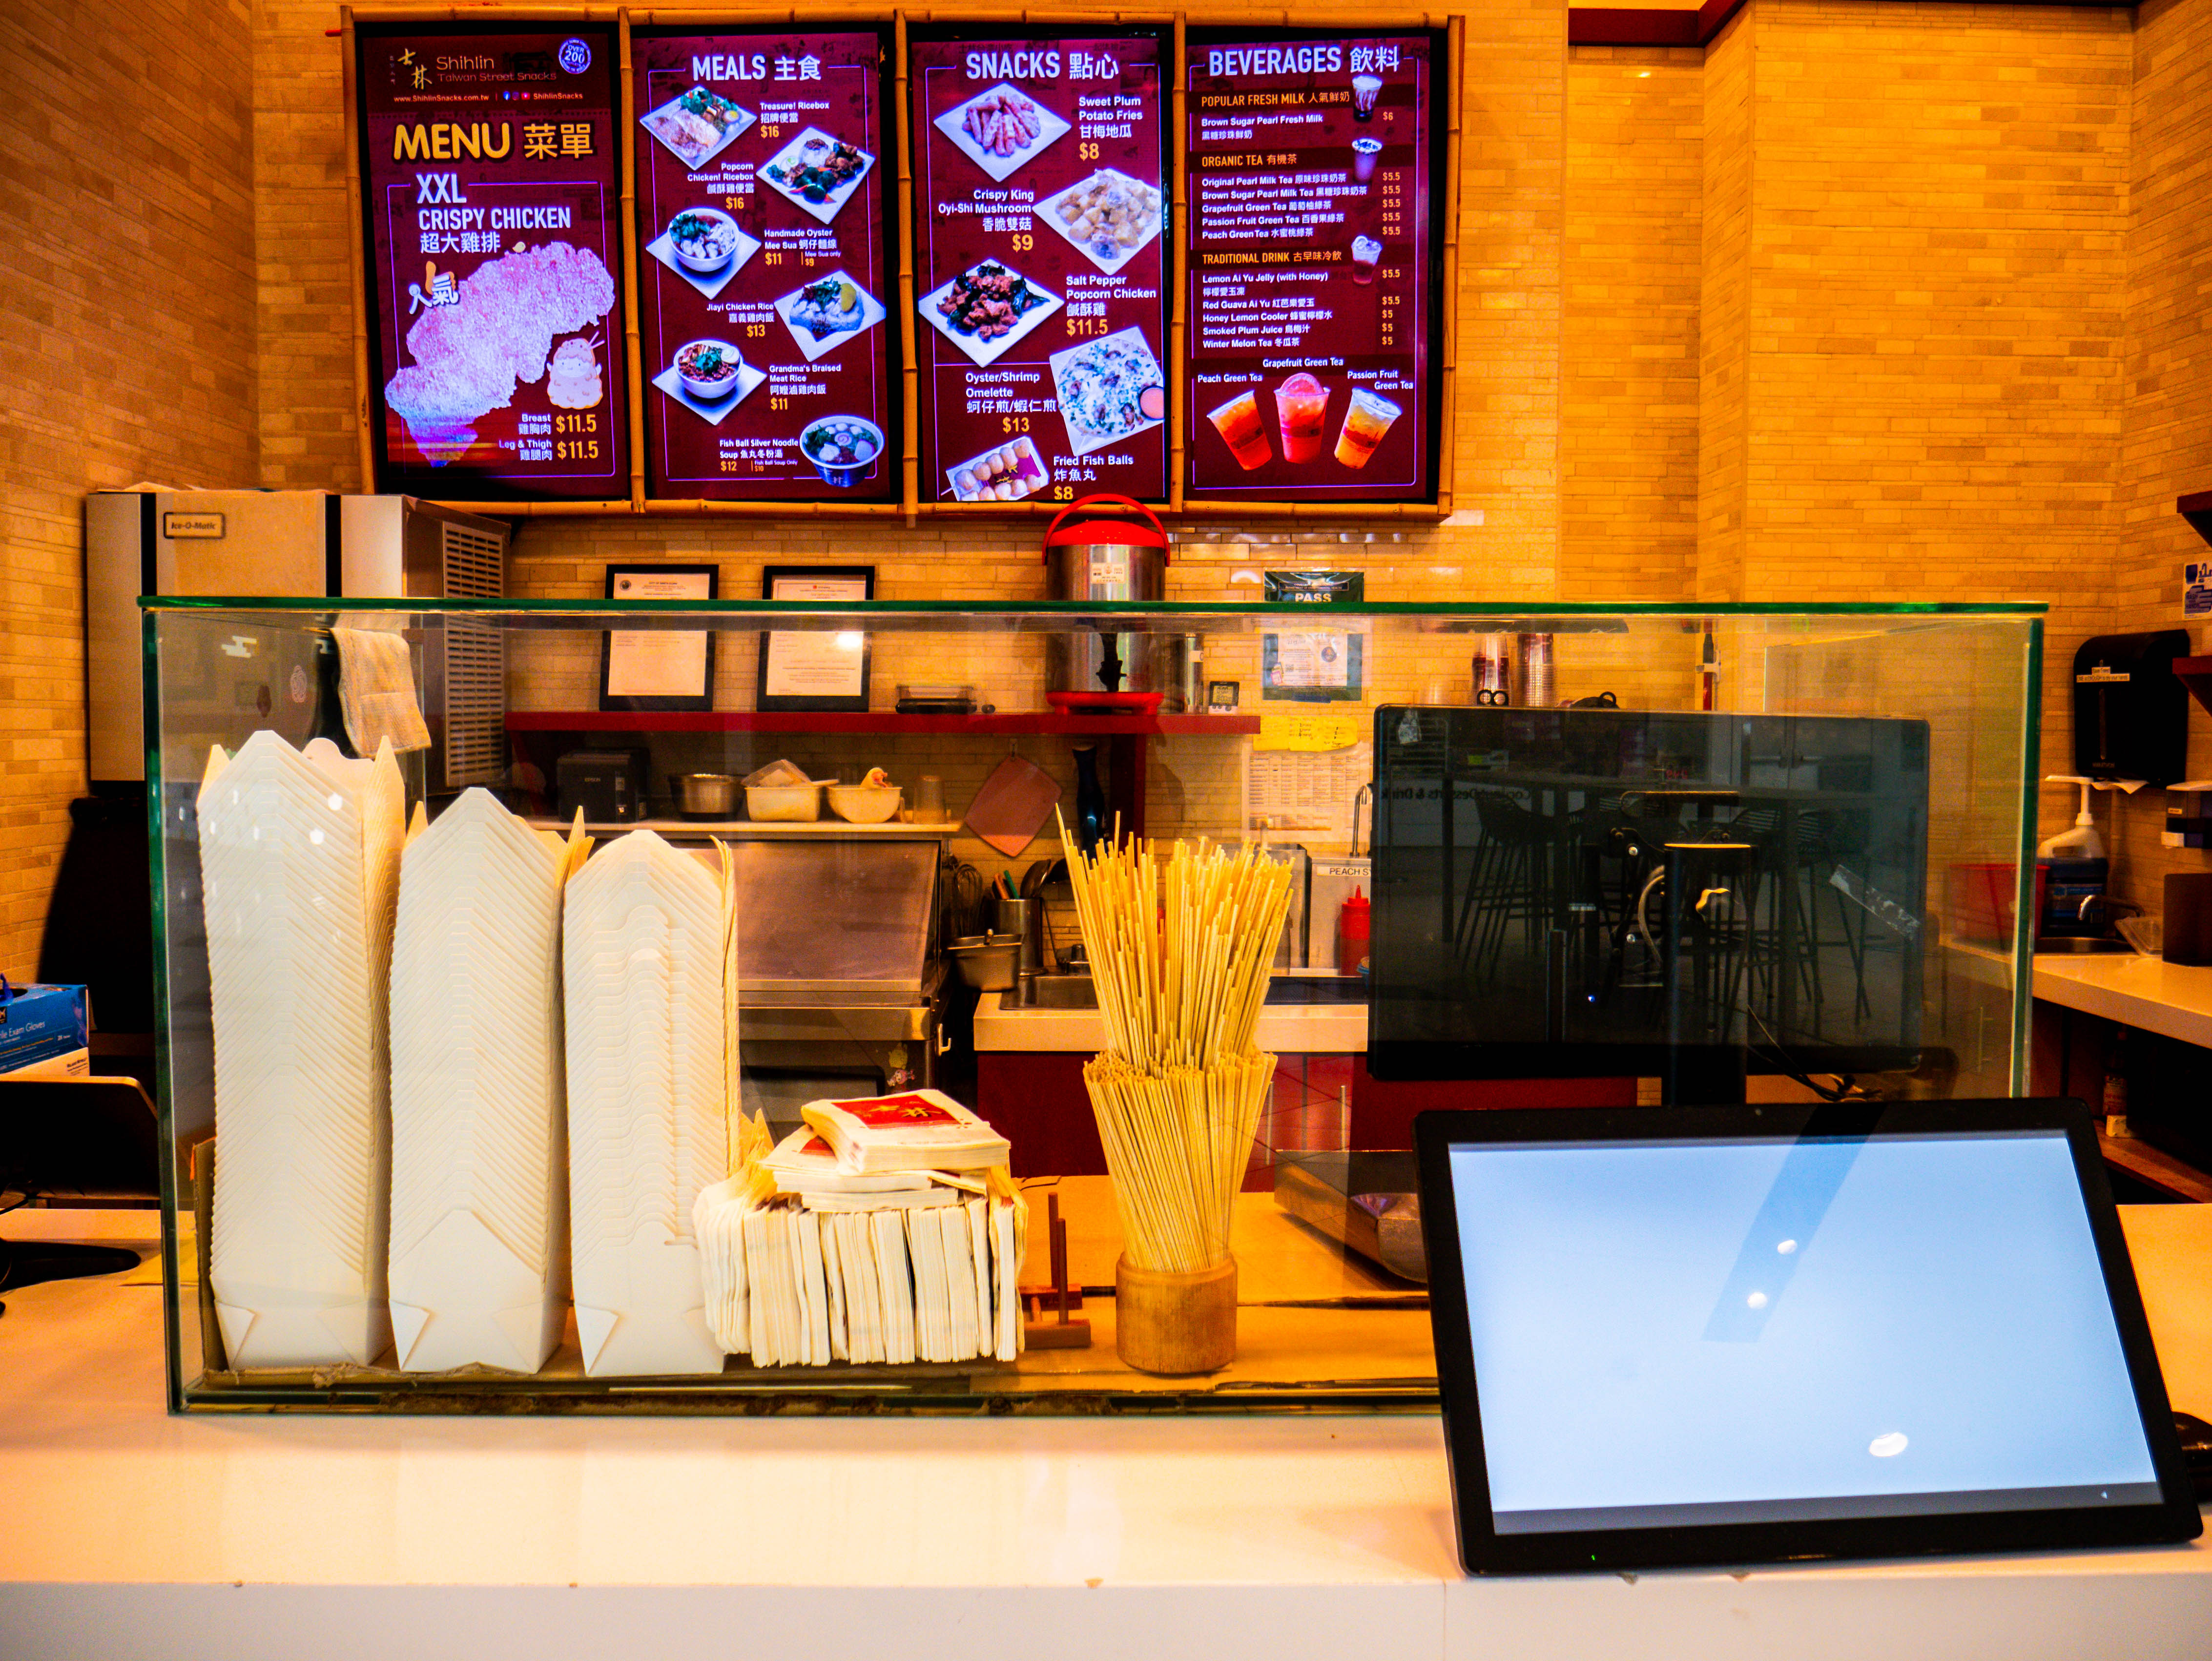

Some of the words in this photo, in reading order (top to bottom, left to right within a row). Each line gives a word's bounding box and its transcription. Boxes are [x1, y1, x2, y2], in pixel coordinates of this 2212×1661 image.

[564, 49, 585, 64] 200
[1210, 46, 1341, 76] BEVERAGES
[1350, 46, 1399, 73] 飲料
[397, 48, 432, 89] 士林
[437, 56, 494, 70] Shihlin
[693, 55, 765, 81] MEALS
[774, 55, 821, 81] 主食
[967, 52, 1060, 79] SNACKS
[1070, 53, 1118, 79] 點心
[438, 73, 476, 82] Taiwan
[479, 73, 514, 82] Street
[517, 72, 557, 81] Snacks
[1079, 97, 1111, 106] Sweet
[1114, 96, 1140, 105] Plum
[1202, 95, 1244, 106] POPULAR
[1248, 94, 1278, 104] FRESH
[1282, 93, 1304, 104] MILK
[1309, 91, 1349, 103] 人氣鮮奶
[761, 112, 798, 123] 招牌便當
[1079, 111, 1114, 120] Potato
[1117, 110, 1142, 120] Fries
[1383, 112, 1393, 120] $6
[1231, 117, 1255, 126] Sugar
[761, 125, 779, 138] $16
[1080, 124, 1131, 138] 甘梅地瓜
[394, 123, 510, 159] MENU
[524, 124, 593, 159] 菜單
[1080, 142, 1099, 161] $8
[1202, 156, 1242, 166] ORGANIC
[1246, 155, 1262, 165] TEA
[1267, 154, 1296, 165] 有機茶
[722, 163, 753, 171] Popcorn
[416, 173, 467, 204] XXL
[1202, 178, 1234, 187] Original
[974, 190, 1008, 201] Crispy
[1011, 189, 1034, 202] King
[726, 197, 744, 209] $16
[939, 203, 972, 215] Oyi-Shi
[975, 203, 1031, 213] Mushroom
[419, 208, 484, 230] CRISPY
[491, 207, 570, 229] CHICKEN
[983, 217, 1031, 231] 香脆雙菇
[807, 229, 832, 238] Oyster
[420, 231, 500, 253] 超大雞排
[1013, 234, 1033, 252] $9
[765, 252, 781, 265] $11
[805, 258, 814, 266] $9
[1203, 253, 1259, 264] TRADITIONAL
[1262, 252, 1289, 262] DRINK
[1294, 251, 1341, 261] 古早味冷飲
[1066, 276, 1086, 285] Salt
[1090, 275, 1126, 287] Pepper
[1256, 274, 1274, 283] Jelly
[1277, 273, 1296, 282] (with
[1299, 272, 1328, 281] Honey)
[408, 273, 459, 314] 人氣
[1067, 290, 1110, 301] Popcorn
[1114, 289, 1156, 298] Chicken
[1067, 302, 1105, 316] 鹹酥雞
[747, 325, 765, 337] $13
[1067, 319, 1108, 336] $11.5
[1263, 358, 1302, 368] Grapefruit
[1330, 357, 1343, 366] Tea
[966, 372, 1039, 384] Oyster/Shrimp
[1224, 374, 1246, 382] Green
[966, 388, 1013, 397] Omelette
[771, 397, 787, 410] $11
[518, 423, 551, 435] 雞胸肉
[556, 415, 596, 433] $11.5
[1003, 417, 1029, 433] $13
[499, 441, 515, 450] Leg
[527, 440, 552, 450] Thigh
[558, 441, 598, 459] $11.5
[520, 449, 552, 460] 雞腿肉
[720, 451, 738, 459] Soup
[1054, 455, 1079, 465] Fried
[1083, 456, 1104, 465] Fish
[1108, 455, 1133, 465] Balls
[721, 461, 737, 471] $12
[1054, 469, 1096, 481] 炸魚丸
[1054, 486, 1073, 499] $8
[1295, 593, 1331, 602] PASS
[9, 1027, 24, 1037] Exam
[26, 1021, 45, 1032] Gloves
